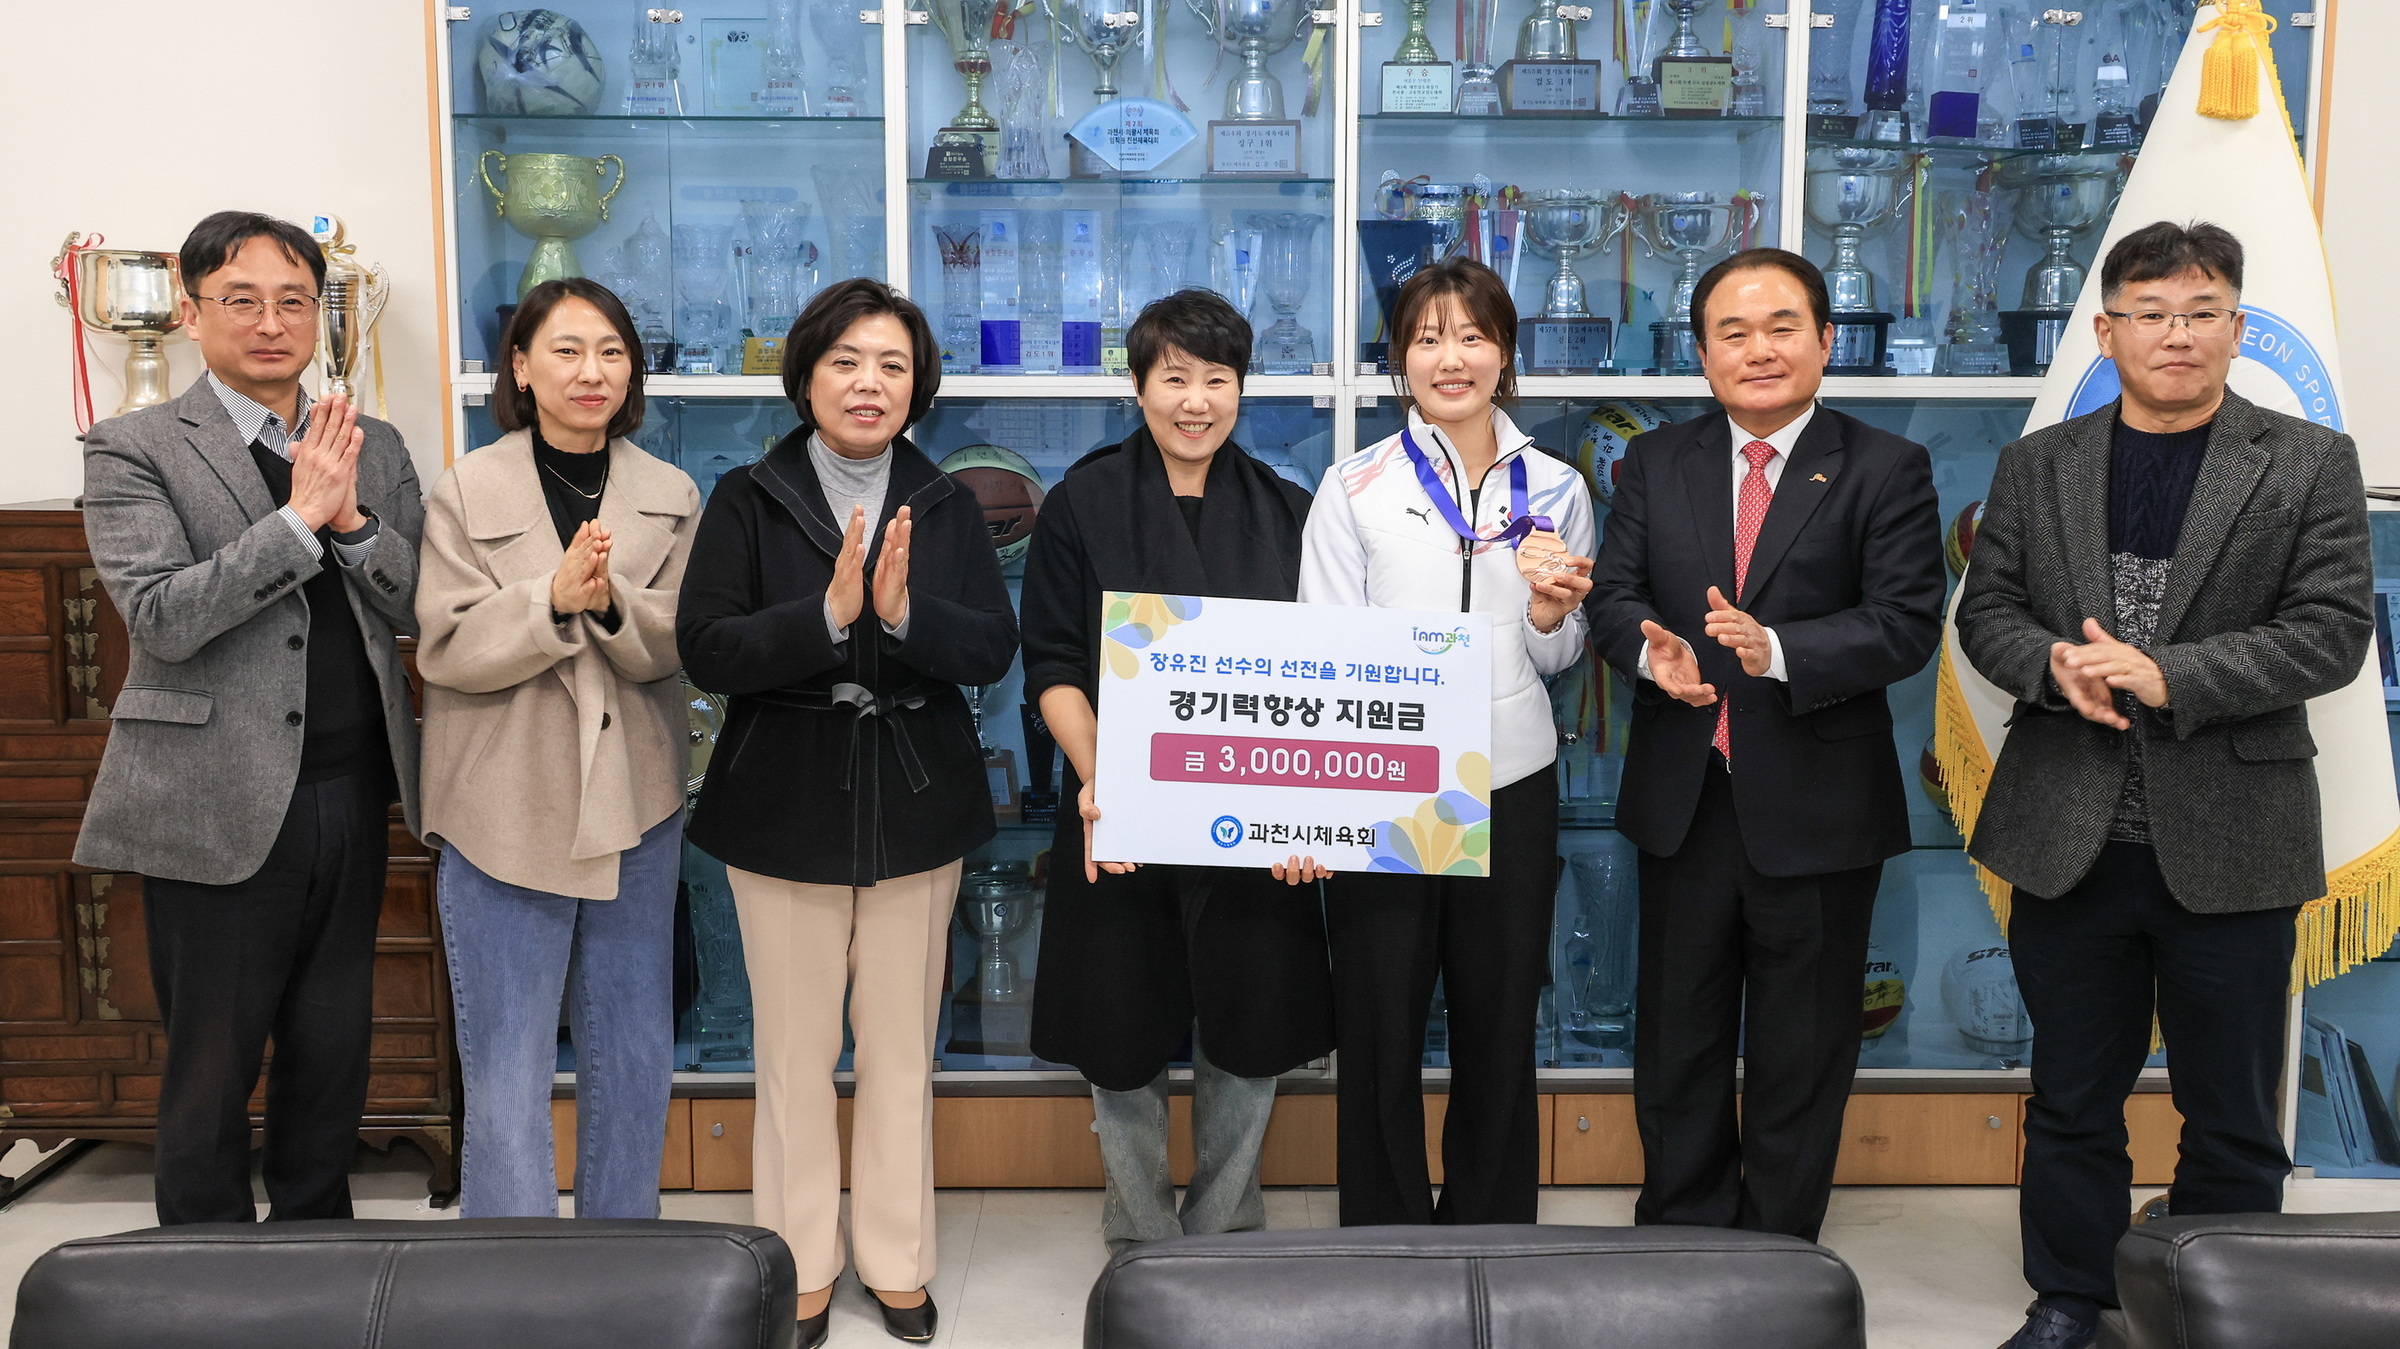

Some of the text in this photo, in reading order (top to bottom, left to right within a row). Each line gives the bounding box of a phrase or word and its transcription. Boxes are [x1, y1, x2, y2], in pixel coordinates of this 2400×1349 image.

[2241, 325, 2294, 363] EON
[1592, 406, 1637, 430] tar
[1150, 653, 1445, 686] 장유진 선수의 선전을 기원합니다.
[1169, 690, 1426, 732] 경기력향상 지원금
[1184, 745, 1407, 782] 금 3,000,000원
[1248, 823, 1376, 848] 과천시체육회
